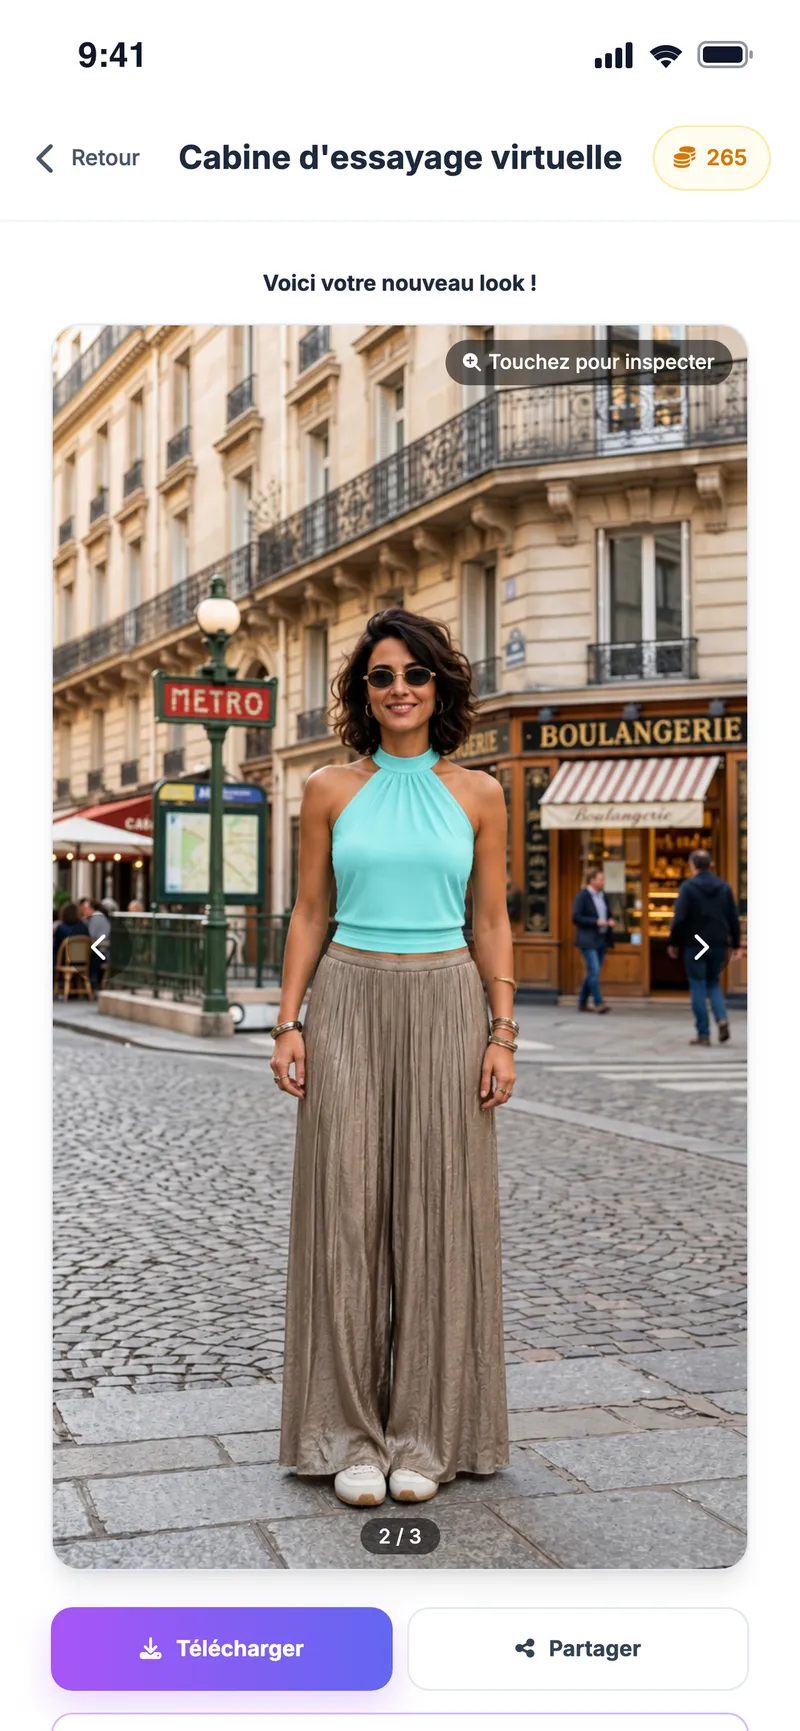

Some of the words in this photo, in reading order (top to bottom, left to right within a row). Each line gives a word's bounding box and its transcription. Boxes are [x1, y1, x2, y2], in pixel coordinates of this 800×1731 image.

[78, 42, 143, 68] 9:41
[72, 148, 141, 167] Retour
[179, 143, 291, 171] Cabine
[299, 143, 483, 177] d'essayage
[490, 143, 623, 171] virtuelle
[707, 149, 747, 166] 265
[263, 274, 316, 292] Voici
[321, 276, 377, 292] votre
[382, 278, 474, 292] nouveau
[480, 274, 526, 292] look
[530, 274, 537, 292] !
[170, 687, 264, 716] METRO
[540, 717, 742, 748] BOULANGERIE
[176, 1638, 304, 1662] Télécharger
[549, 1639, 642, 1662] Partager
